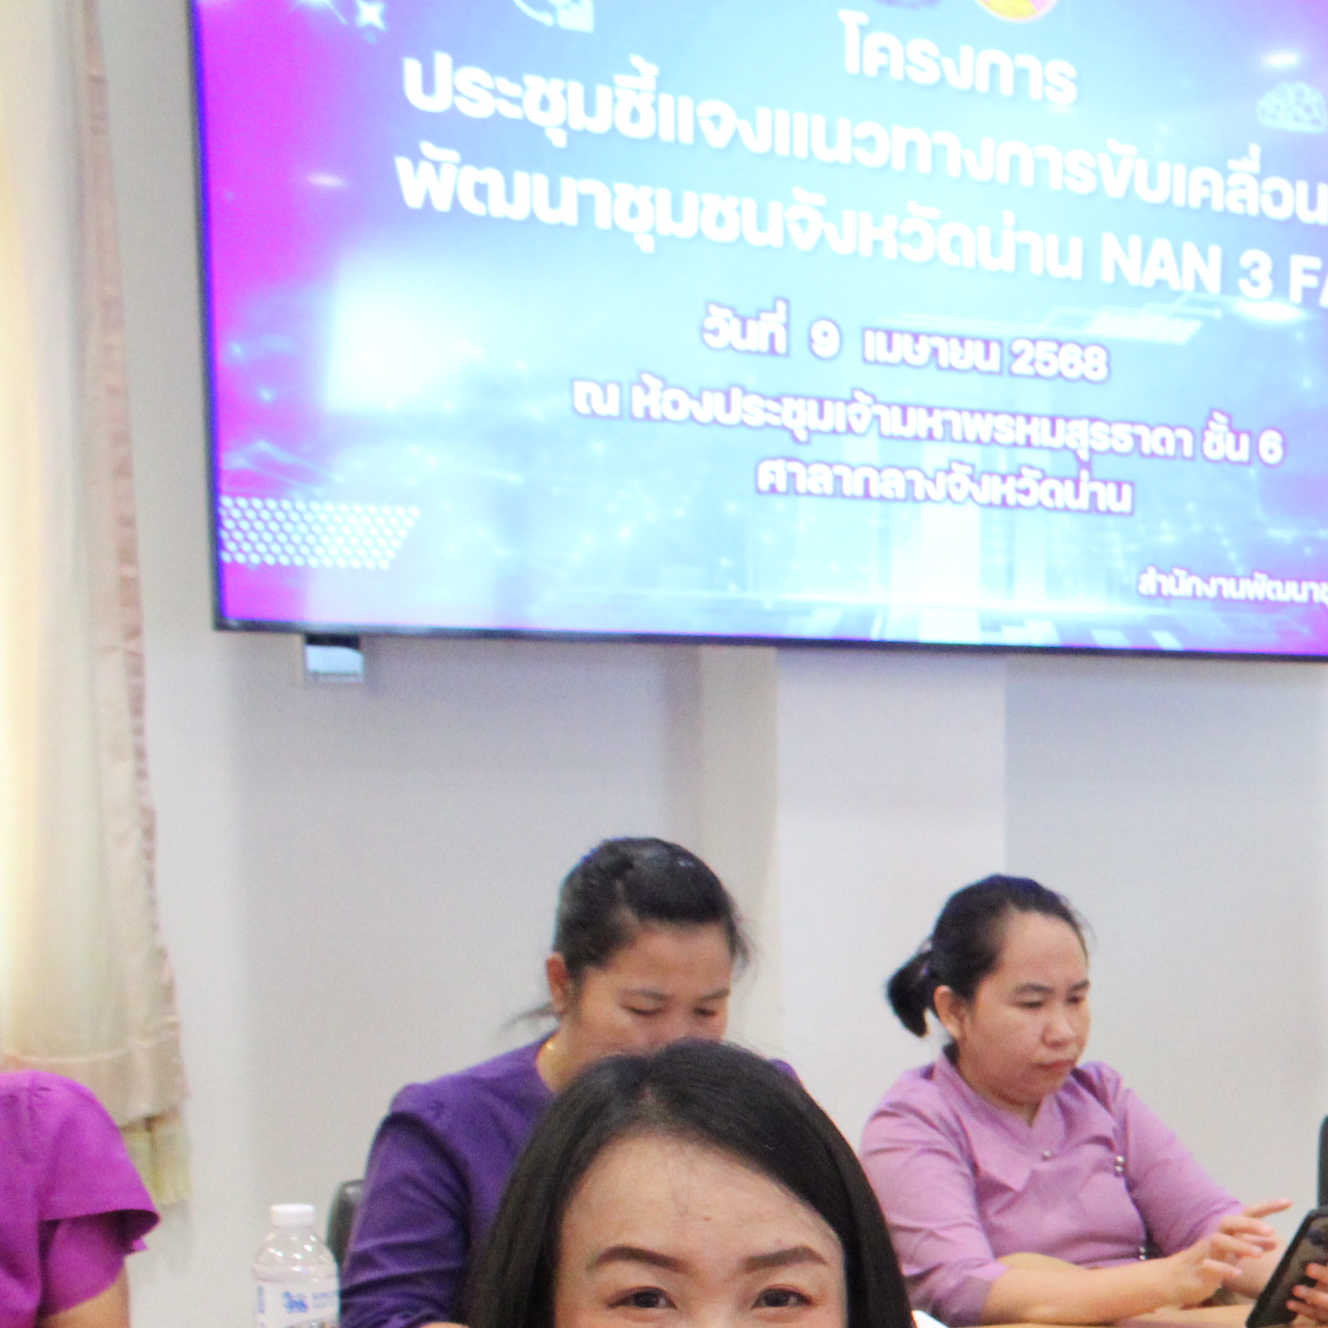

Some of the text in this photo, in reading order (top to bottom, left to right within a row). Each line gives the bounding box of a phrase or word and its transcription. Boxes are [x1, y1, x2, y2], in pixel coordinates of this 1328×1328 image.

[837, 8, 1079, 106] โครงการ
[394, 141, 1082, 282] พัฒนาชุมชนจังหวัดน่าน
[1101, 233, 1223, 295] NAN
[1238, 257, 1274, 302] 3
[701, 299, 1111, 384] วันที่ 9 เมษายน 2568
[571, 379, 619, 420] ณ
[1202, 411, 1251, 464] ชั้น
[1257, 429, 1285, 466] 6
[755, 455, 1134, 515] ศาลากลางจังหวัดน่าน
